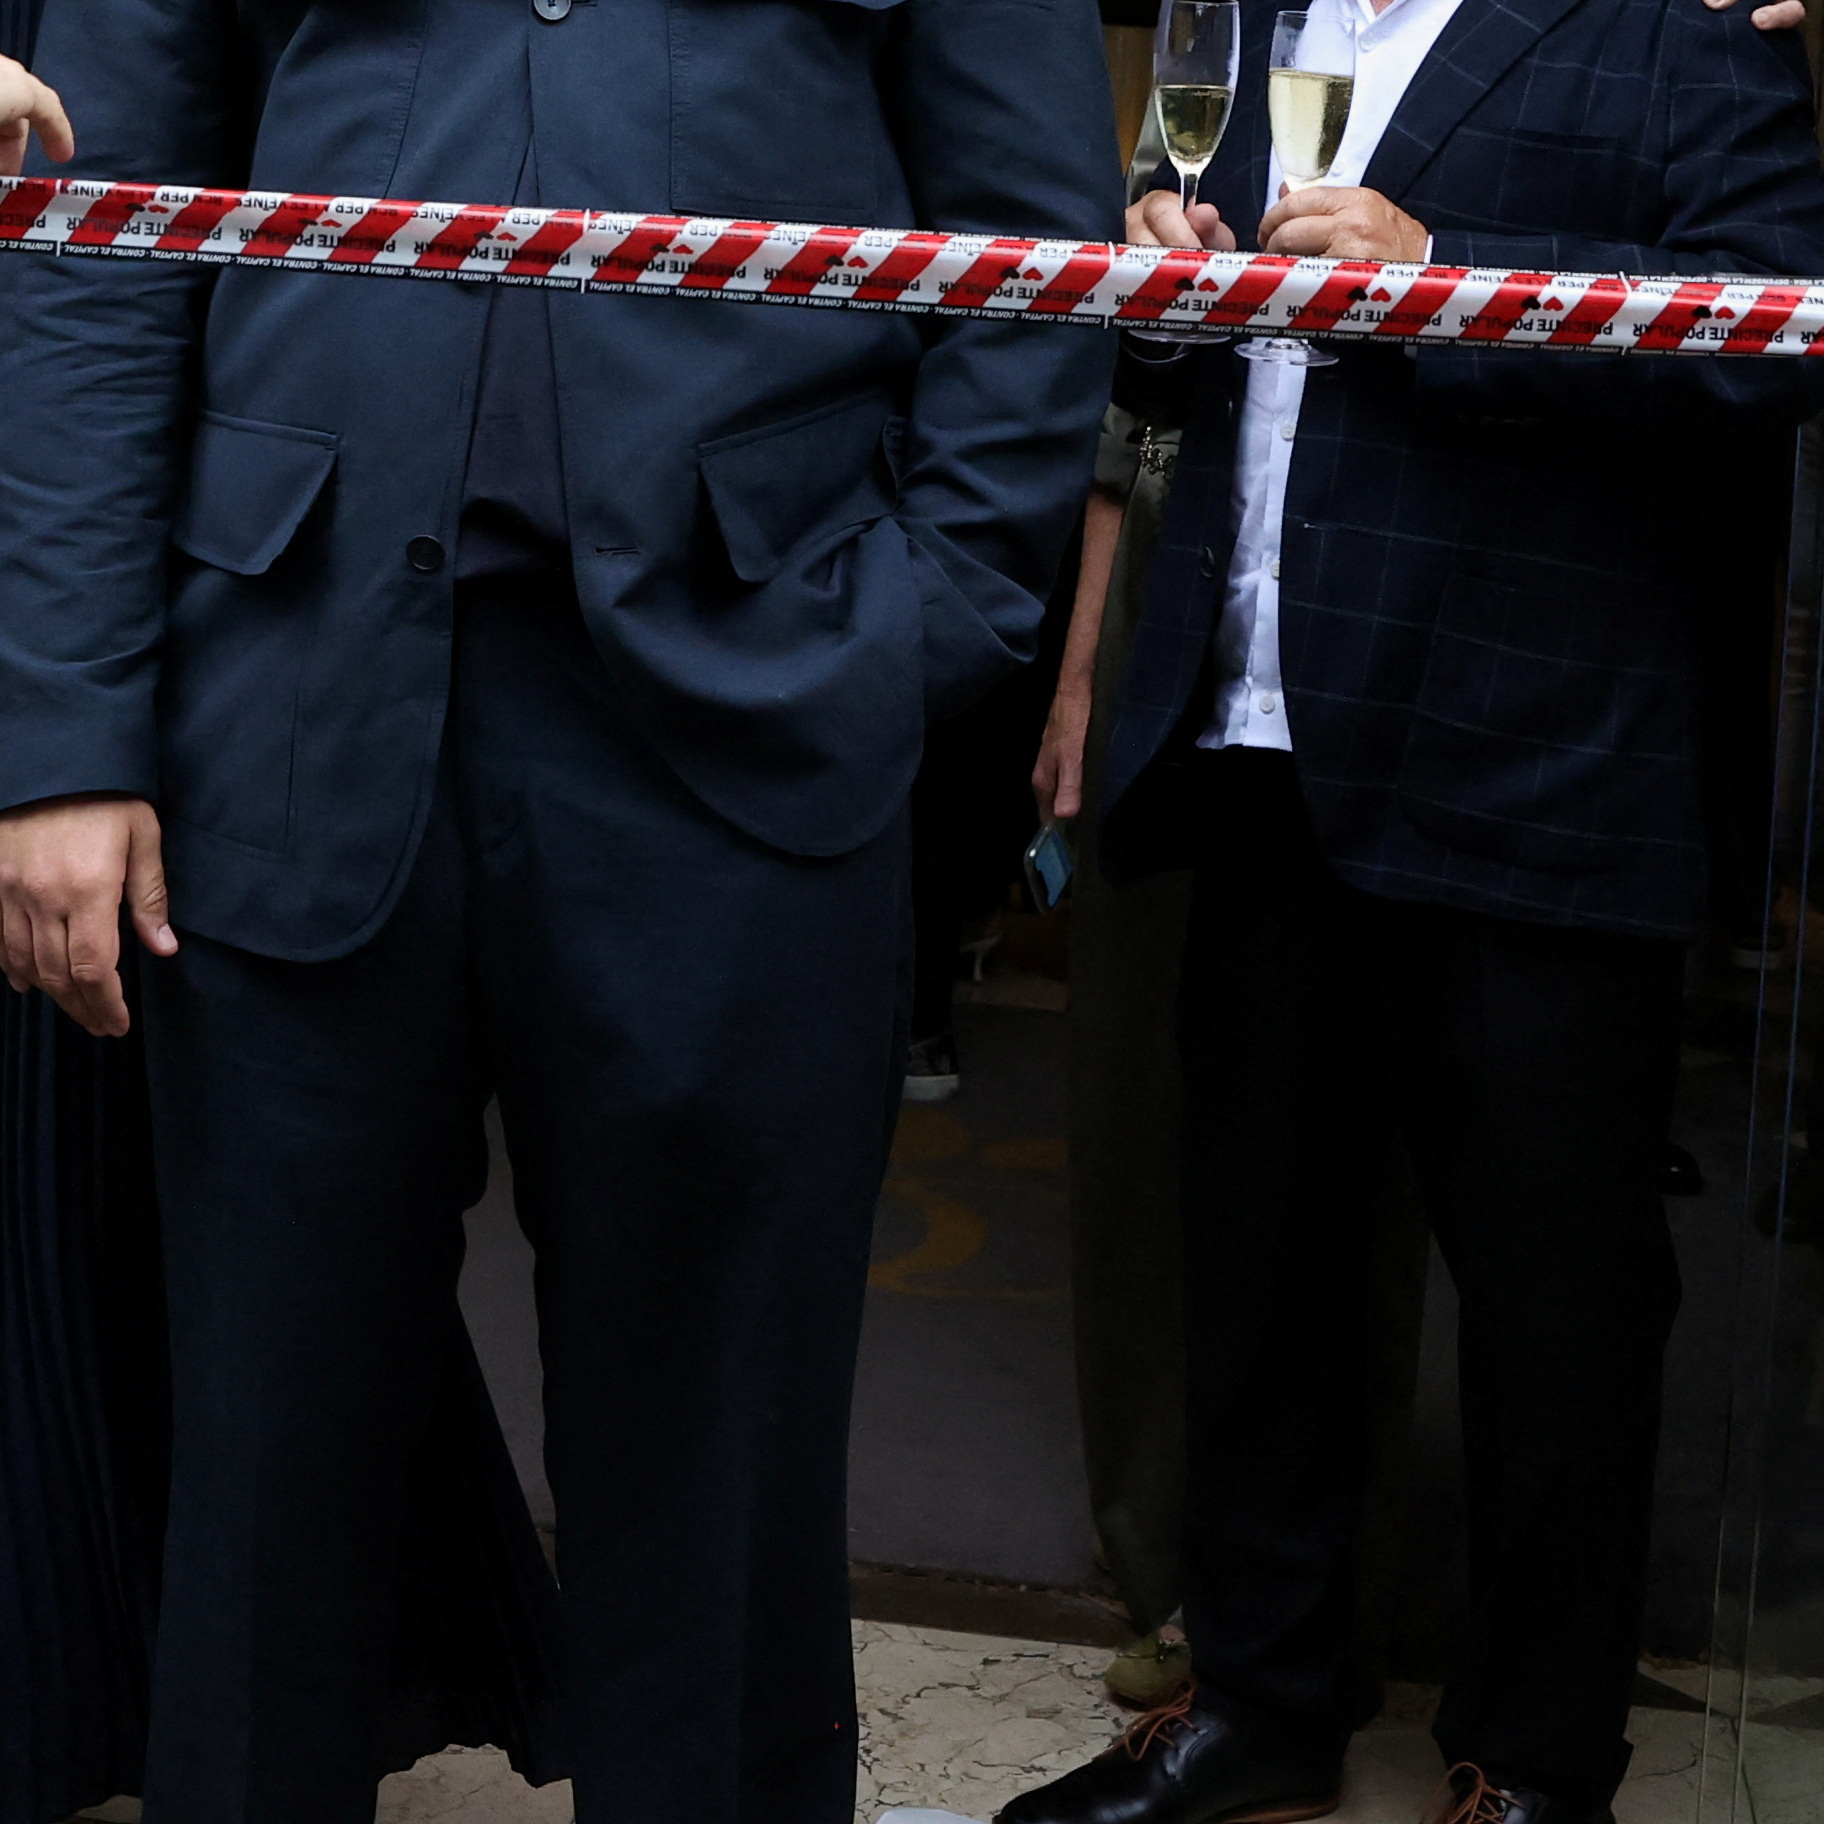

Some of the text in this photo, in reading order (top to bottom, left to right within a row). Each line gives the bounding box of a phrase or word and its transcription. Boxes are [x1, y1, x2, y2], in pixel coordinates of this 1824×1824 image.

[334, 199, 363, 215] PER
[511, 210, 540, 227] PER
[239, 228, 395, 253] PRECINTE POPULAR
[413, 240, 569, 266] PRECINTE POPULAR
[1115, 292, 1268, 316] PRECINTE POPULAR
[1286, 303, 1441, 326] PRECINTE POPULAR
[1632, 322, 1783, 343] PRECINTE POPULAR
